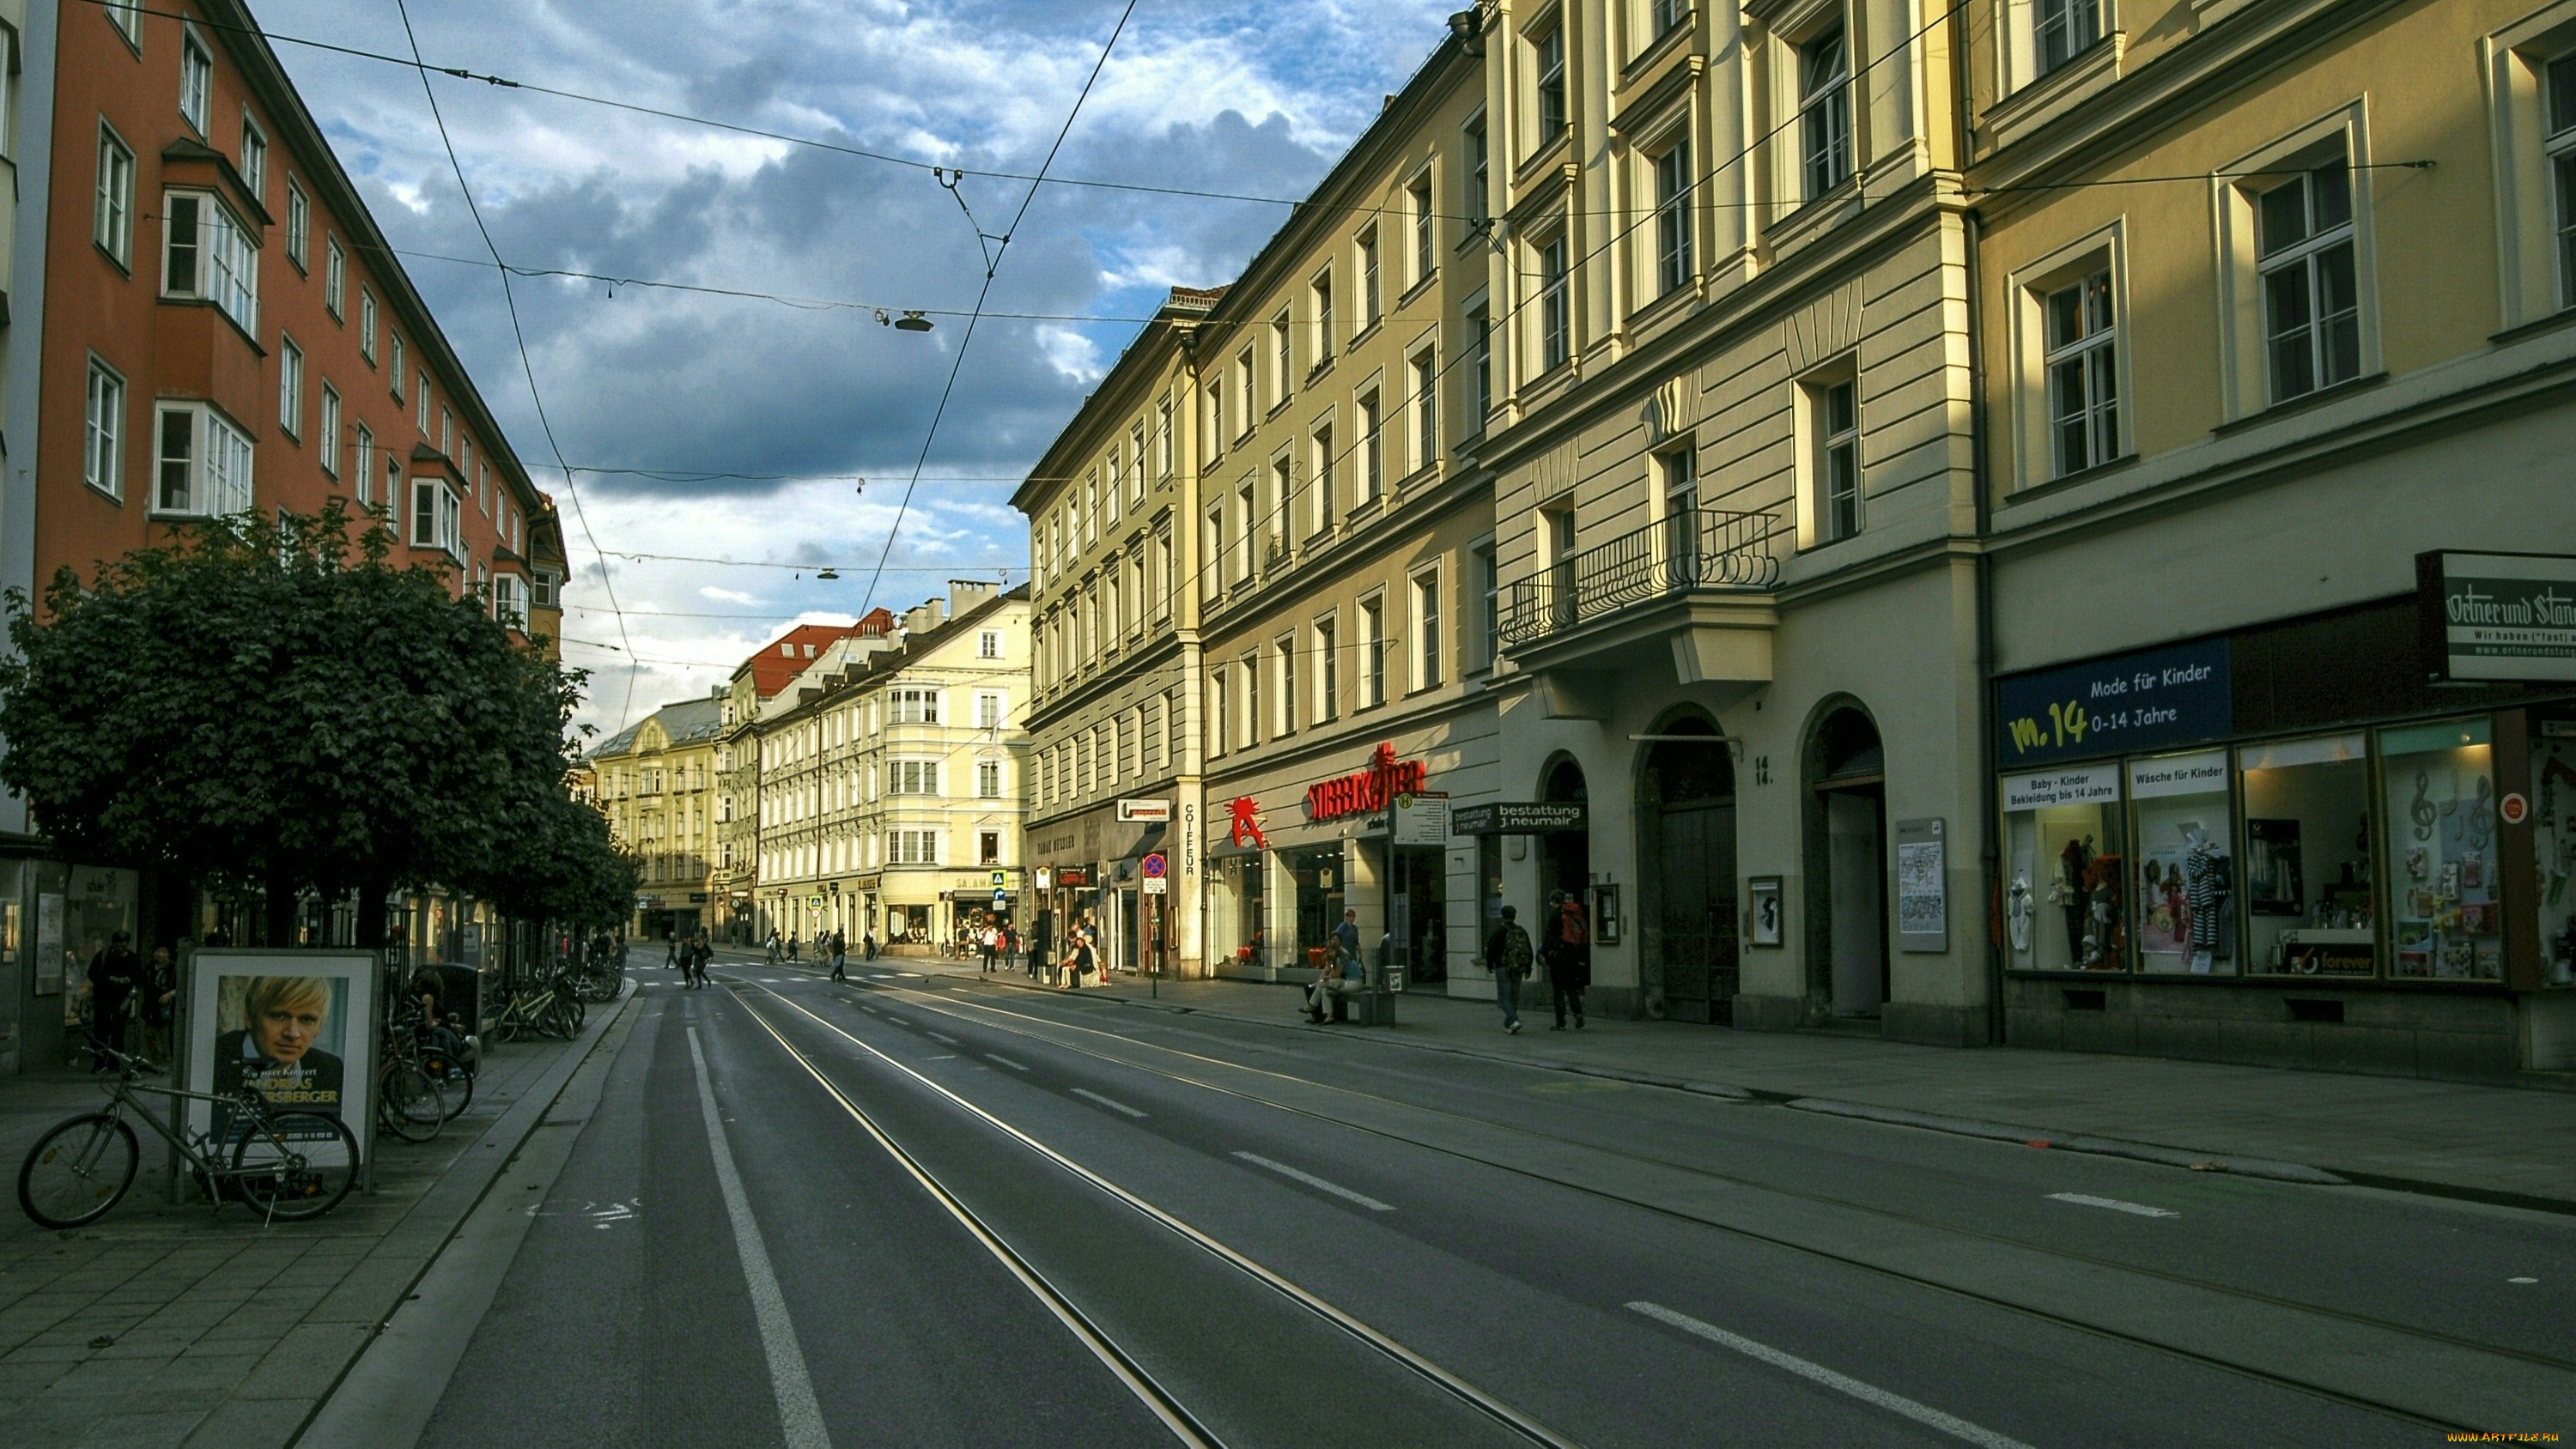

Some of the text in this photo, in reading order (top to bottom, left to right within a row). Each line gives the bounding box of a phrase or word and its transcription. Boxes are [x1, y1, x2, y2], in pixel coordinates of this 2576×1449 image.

[2447, 583, 2500, 624] Ortner
[2502, 597, 2531, 624] und
[2475, 631, 2493, 640] Wir
[2496, 631, 2528, 641] haben
[2091, 664, 2211, 699] Mode für Kinder
[2092, 706, 2178, 732] 0-14 Jahre
[2031, 779, 2052, 791] Baby
[2061, 775, 2089, 787] Kinder
[2136, 767, 2224, 785] Wäsche für Kinder
[2011, 785, 2113, 805] Bekleidung bis 14 Jahre
[1455, 808, 1492, 822] bestattung
[1499, 804, 1580, 818] bestattung
[1185, 803, 1194, 876] COIFFEUR
[2321, 950, 2372, 968] forever
[283, 1067, 317, 1076] Konzert
